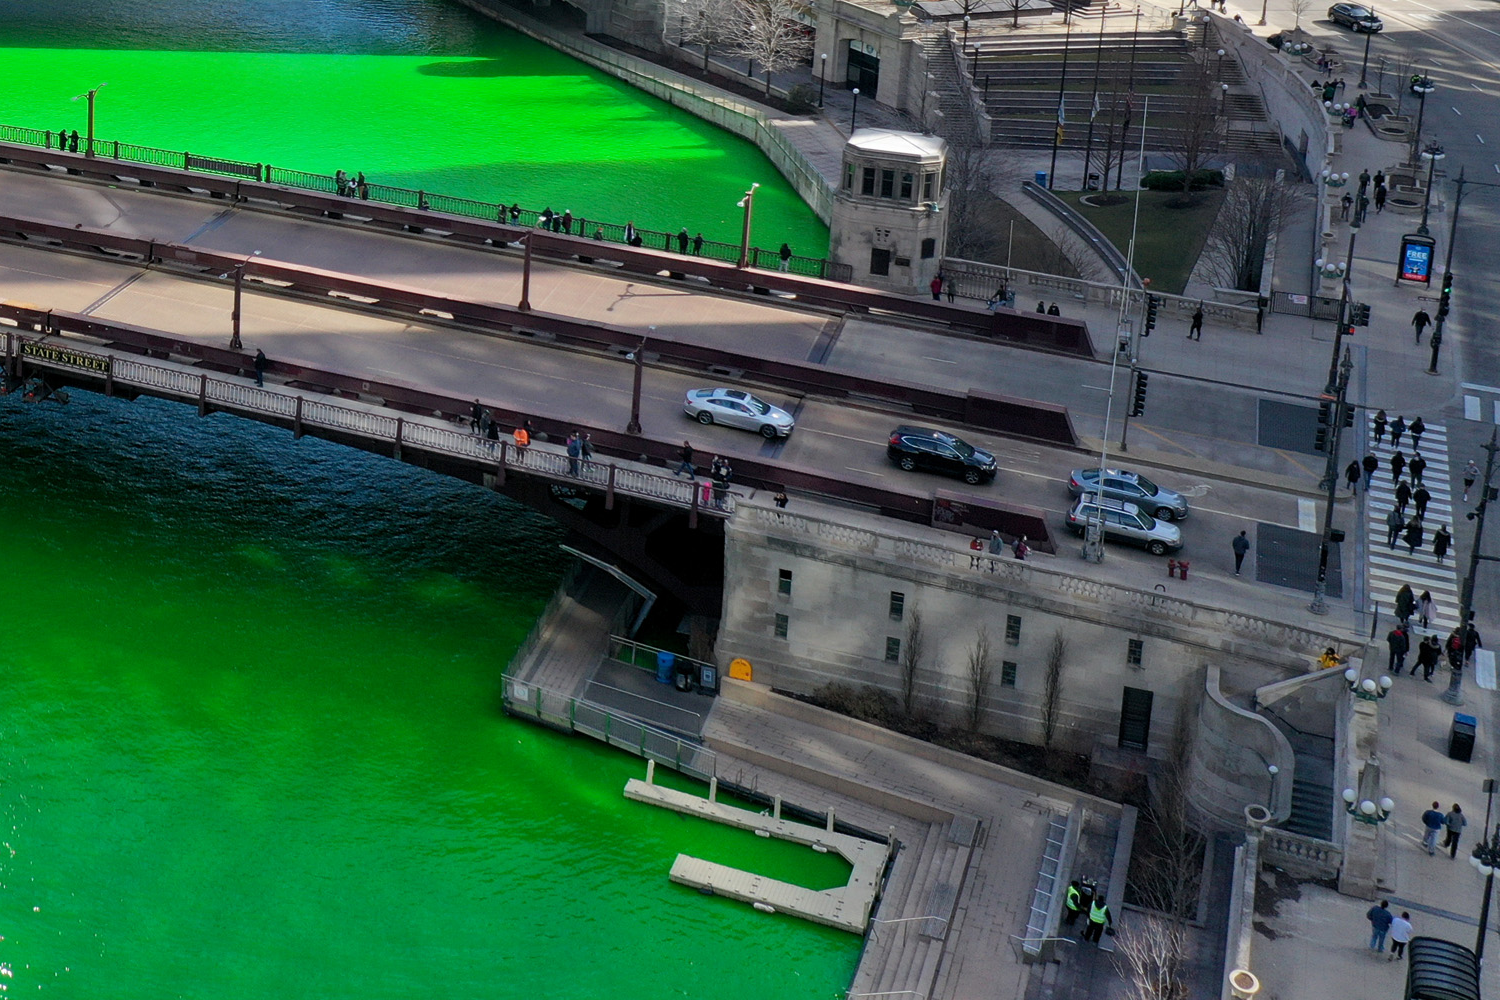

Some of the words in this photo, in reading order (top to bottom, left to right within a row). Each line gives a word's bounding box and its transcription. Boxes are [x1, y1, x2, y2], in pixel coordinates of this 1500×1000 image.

[1407, 250, 1427, 259] FREE
[24, 345, 59, 360] STATE
[61, 354, 107, 371] STREET
